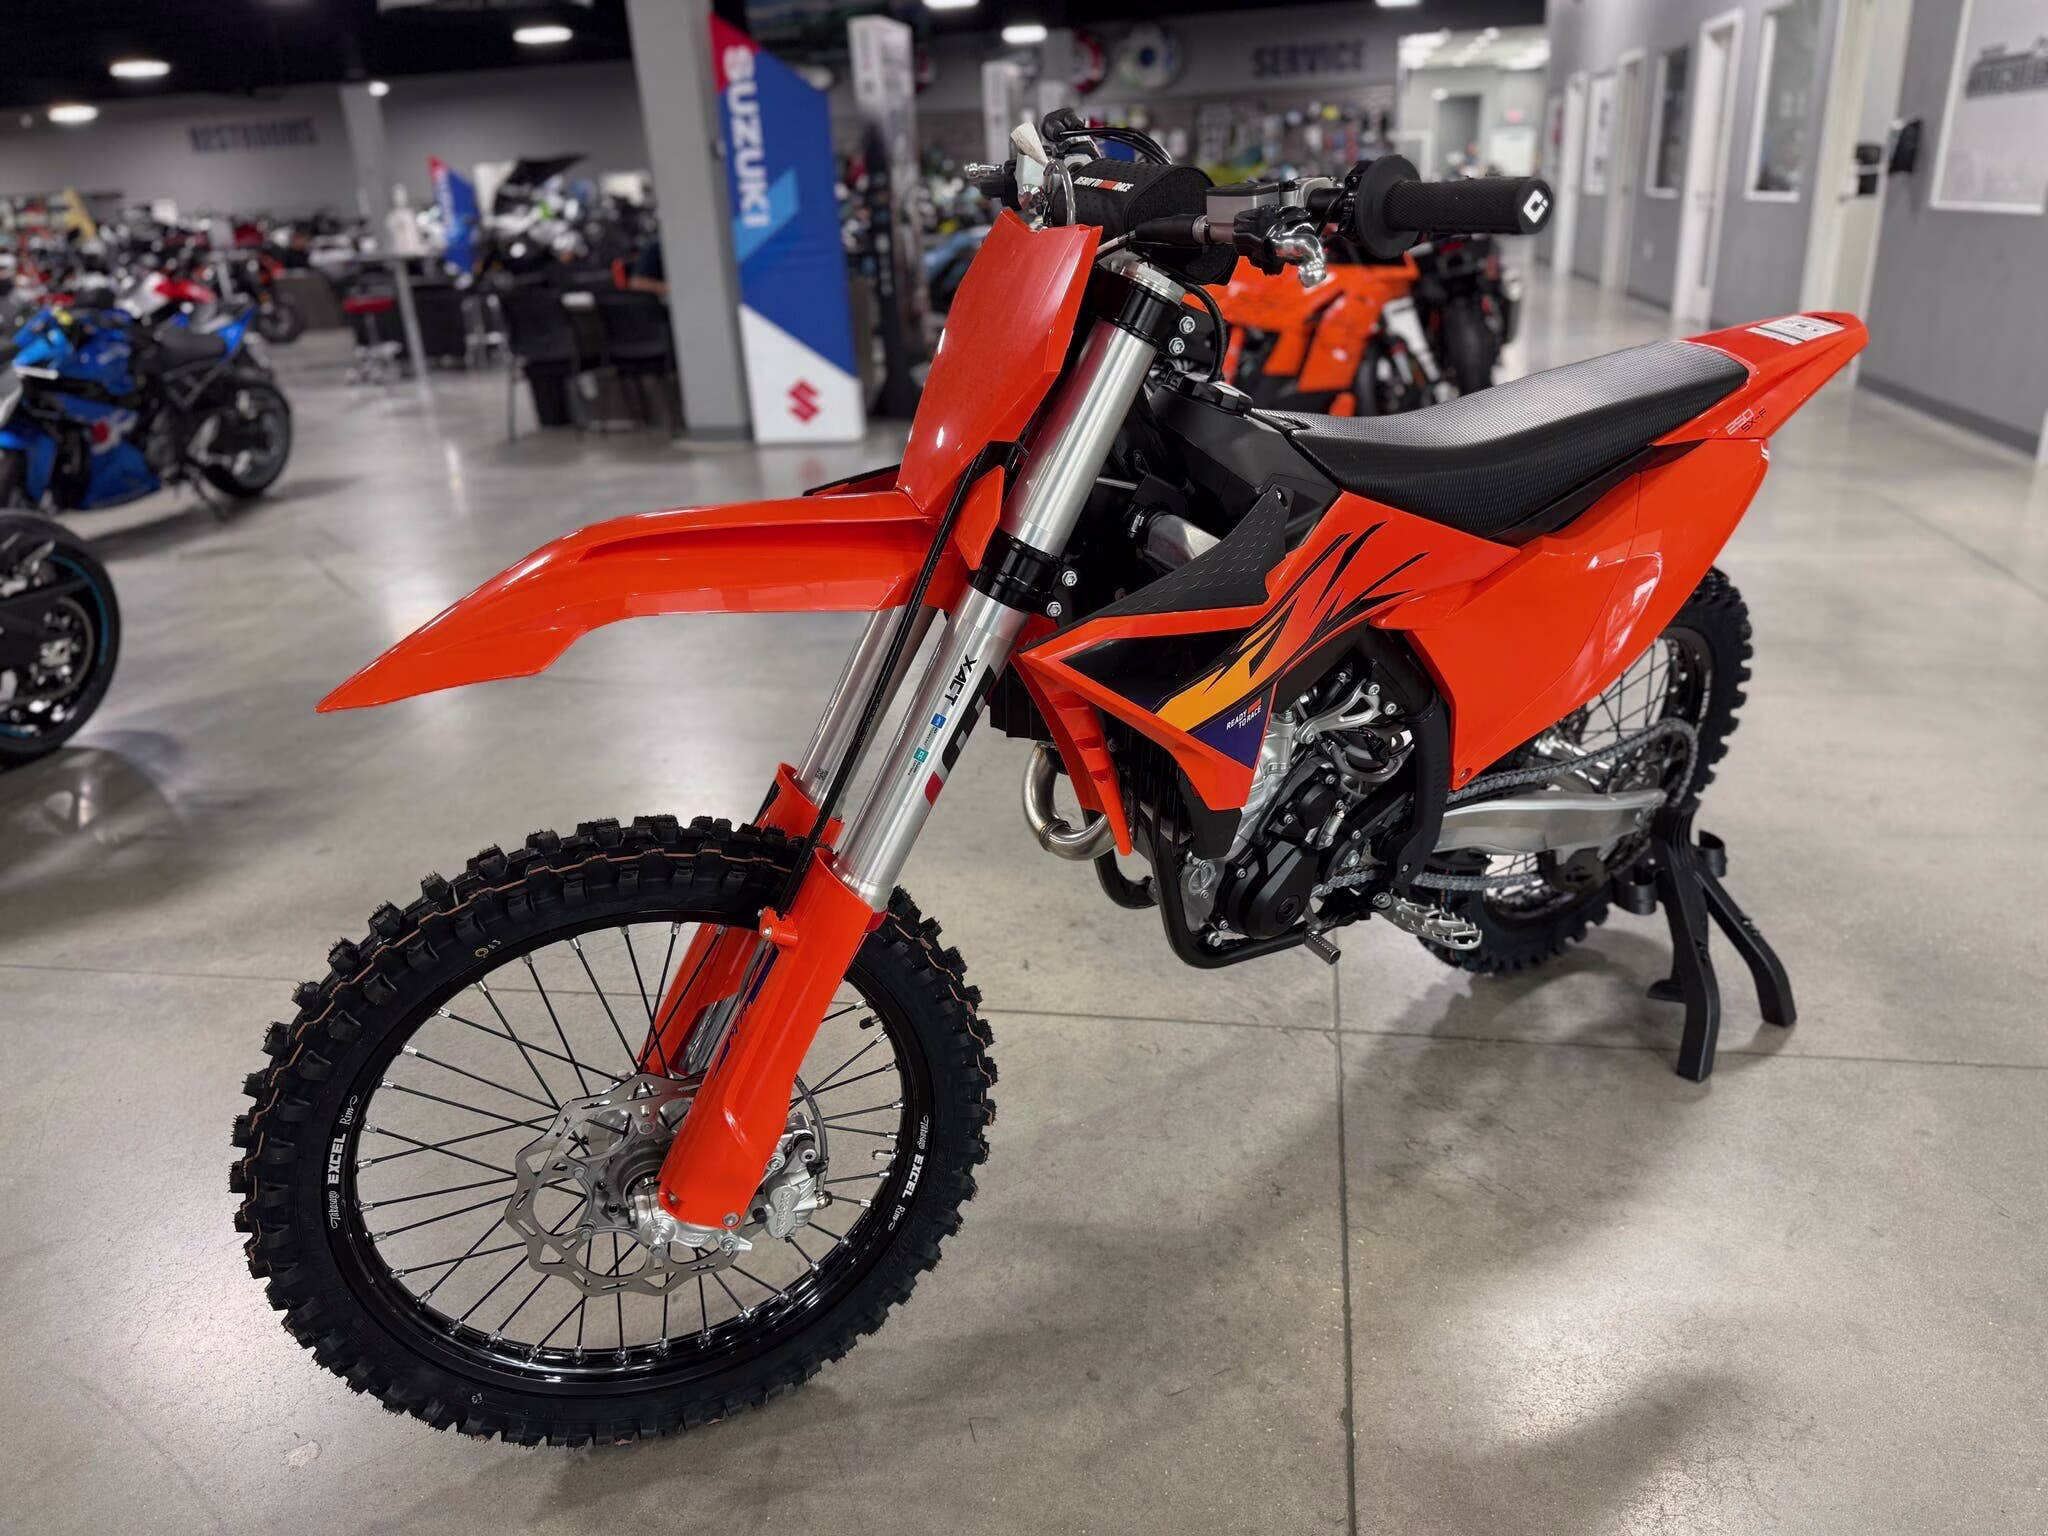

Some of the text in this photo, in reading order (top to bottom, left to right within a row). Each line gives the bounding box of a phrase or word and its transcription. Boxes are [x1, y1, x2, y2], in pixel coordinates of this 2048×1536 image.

[722, 45, 770, 228] SUZUKI
[944, 653, 978, 706] XACT
[1226, 709, 1248, 731] READY
[327, 1133, 347, 1185] EXCEL
[902, 1153, 925, 1198] EXCEL
